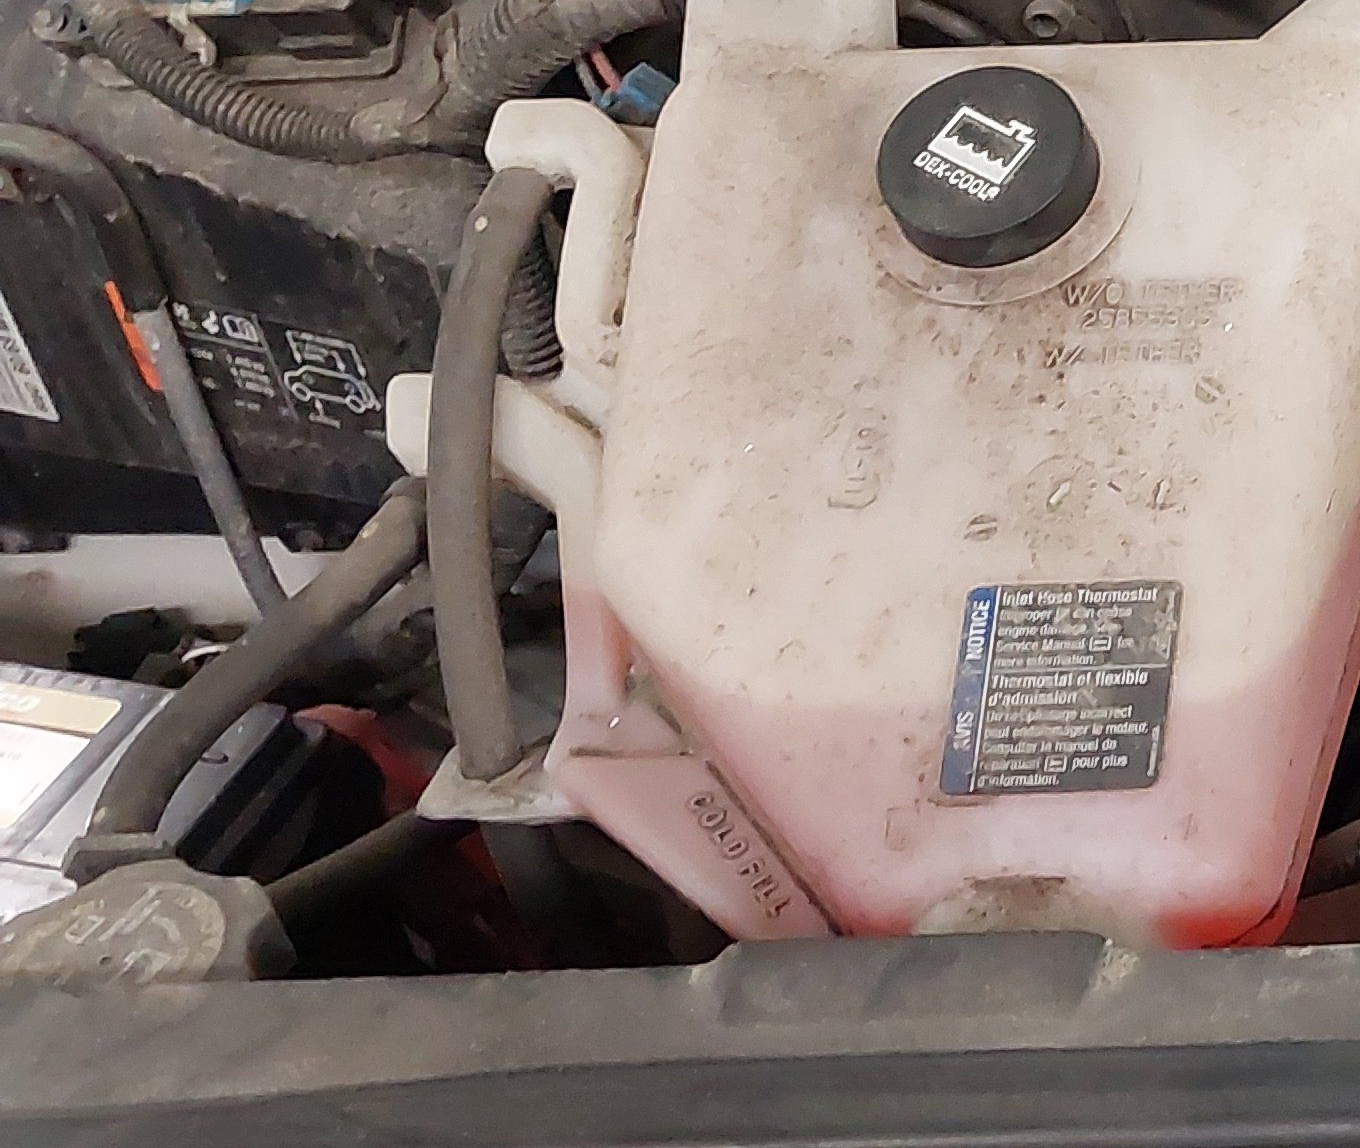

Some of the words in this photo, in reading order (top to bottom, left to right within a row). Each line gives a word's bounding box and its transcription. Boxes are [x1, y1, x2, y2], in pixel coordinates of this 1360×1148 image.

[1002, 590, 1034, 606] Inlet
[1038, 590, 1073, 606] Hose
[1077, 587, 1159, 604] Thermostat
[965, 599, 991, 661] NOTICE
[1095, 669, 1149, 687] flexible
[1071, 755, 1101, 772] pour
[1102, 753, 1129, 770] plus
[687, 792, 749, 860] COLD
[738, 858, 791, 919] FILL
